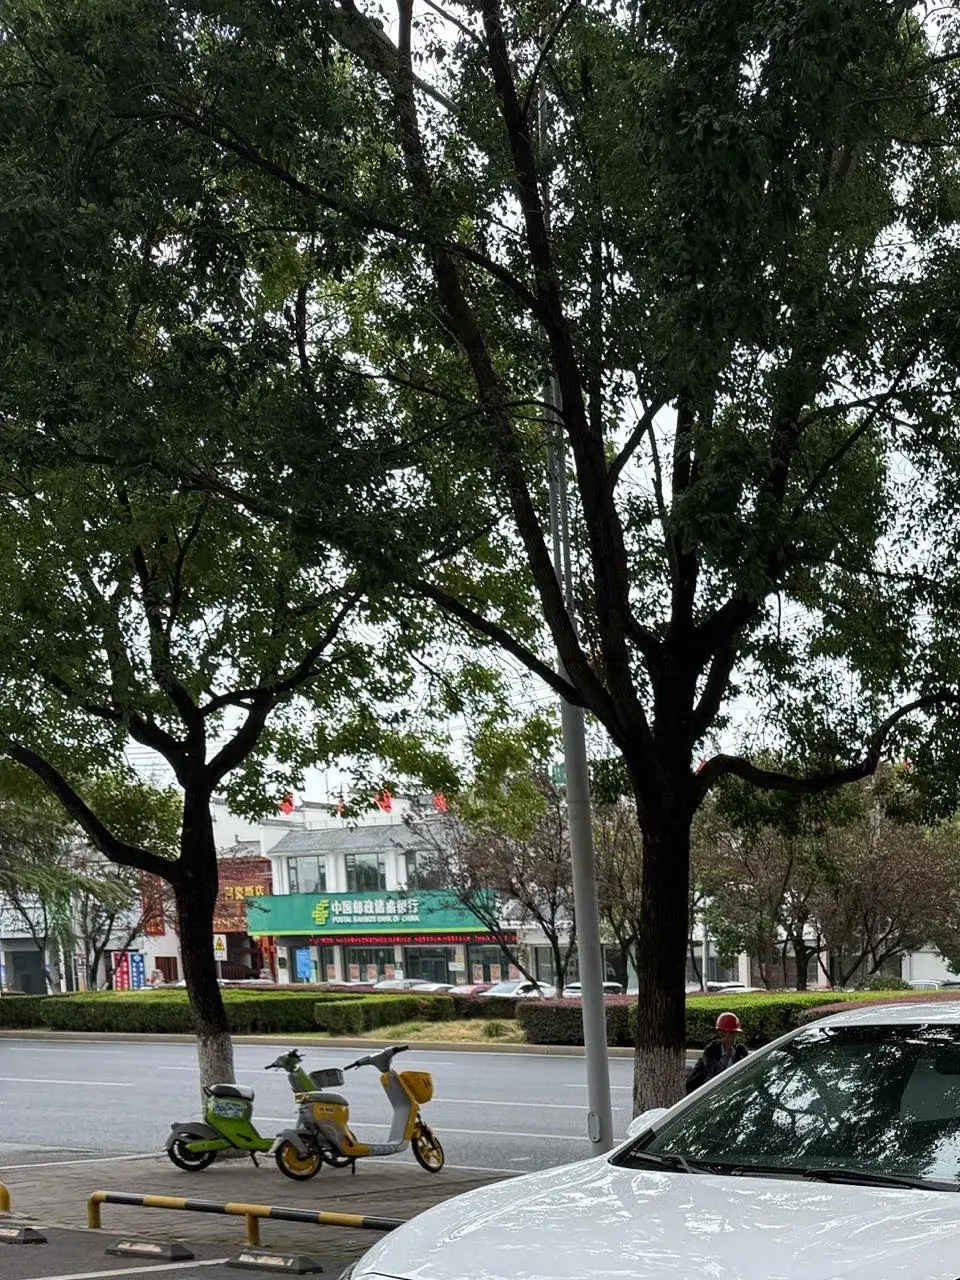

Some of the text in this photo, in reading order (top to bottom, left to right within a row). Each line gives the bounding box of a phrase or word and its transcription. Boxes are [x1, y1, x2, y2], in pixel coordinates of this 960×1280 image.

[331, 899, 419, 914] 中国邮政储蓄银行
